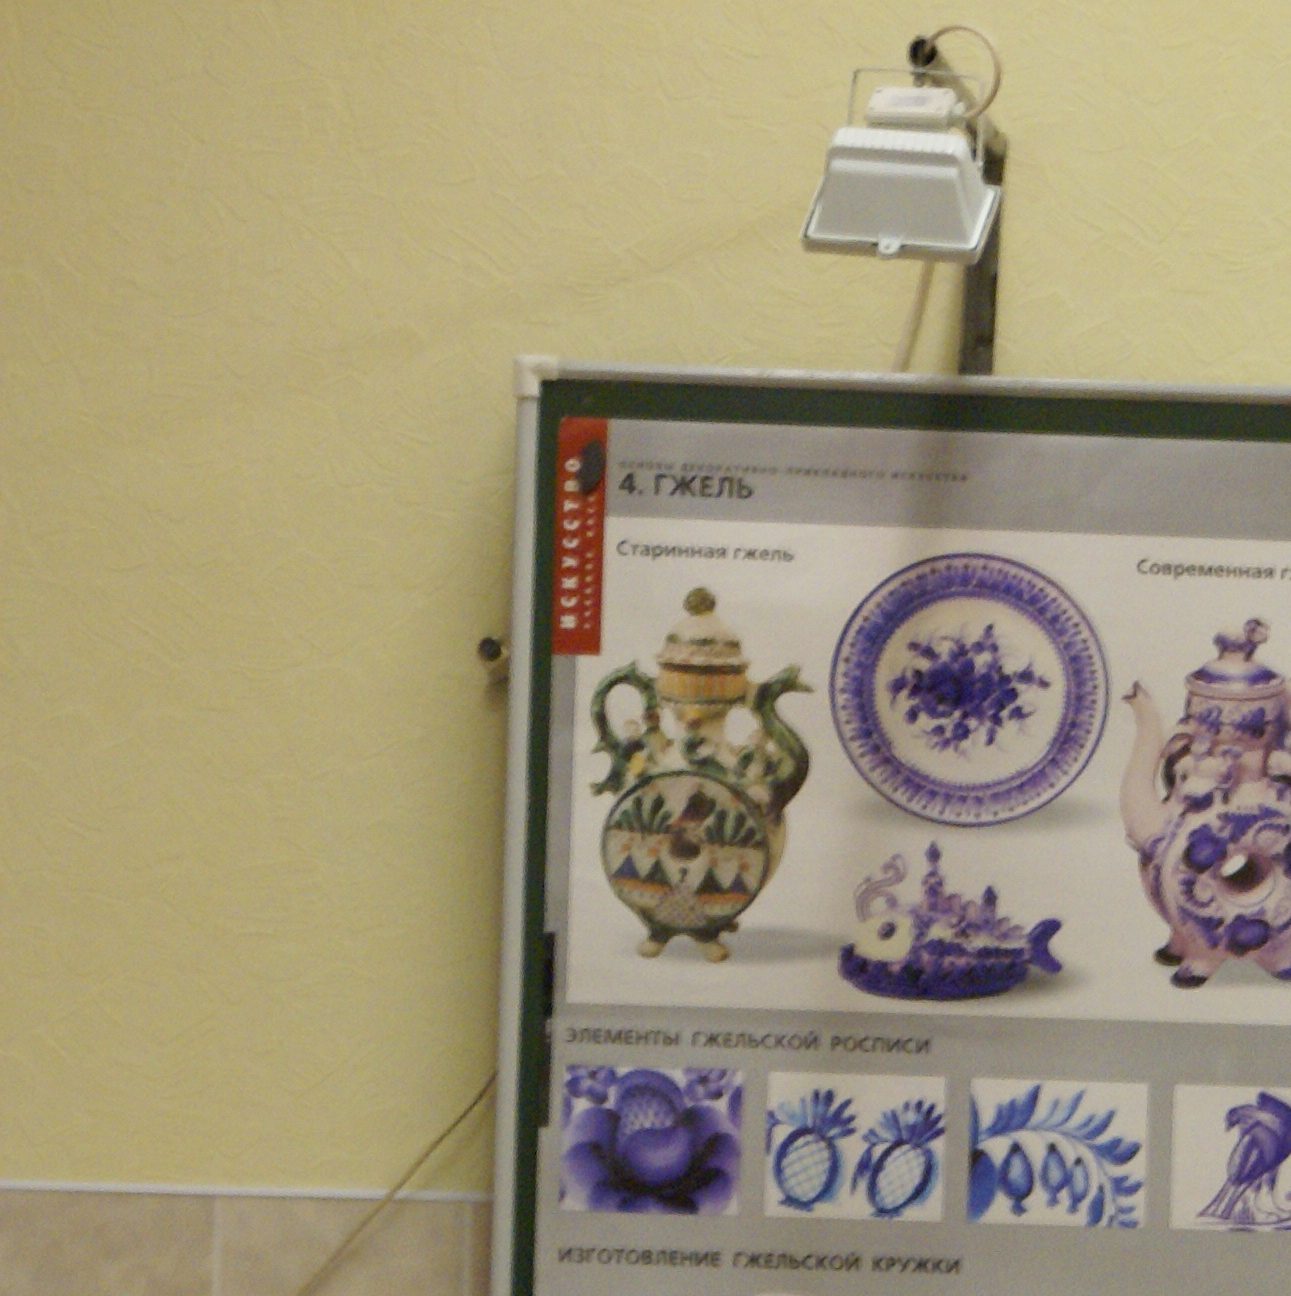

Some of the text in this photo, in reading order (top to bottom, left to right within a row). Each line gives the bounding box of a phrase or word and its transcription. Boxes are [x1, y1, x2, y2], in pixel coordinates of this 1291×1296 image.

[618, 472, 755, 500] 4. ГЖЕЛЬ
[616, 538, 795, 563] Старинная гжель
[1136, 557, 1275, 581] Современная
[565, 1027, 932, 1055] ЭЛЕМЕНТЫ ГЖЕЛЬСКОЙ РОСПИСИ
[557, 1246, 963, 1275] ИЗГОТОВЛЕНИЕ ГЖЕЛЬСКОЙ КРУЖКИ
